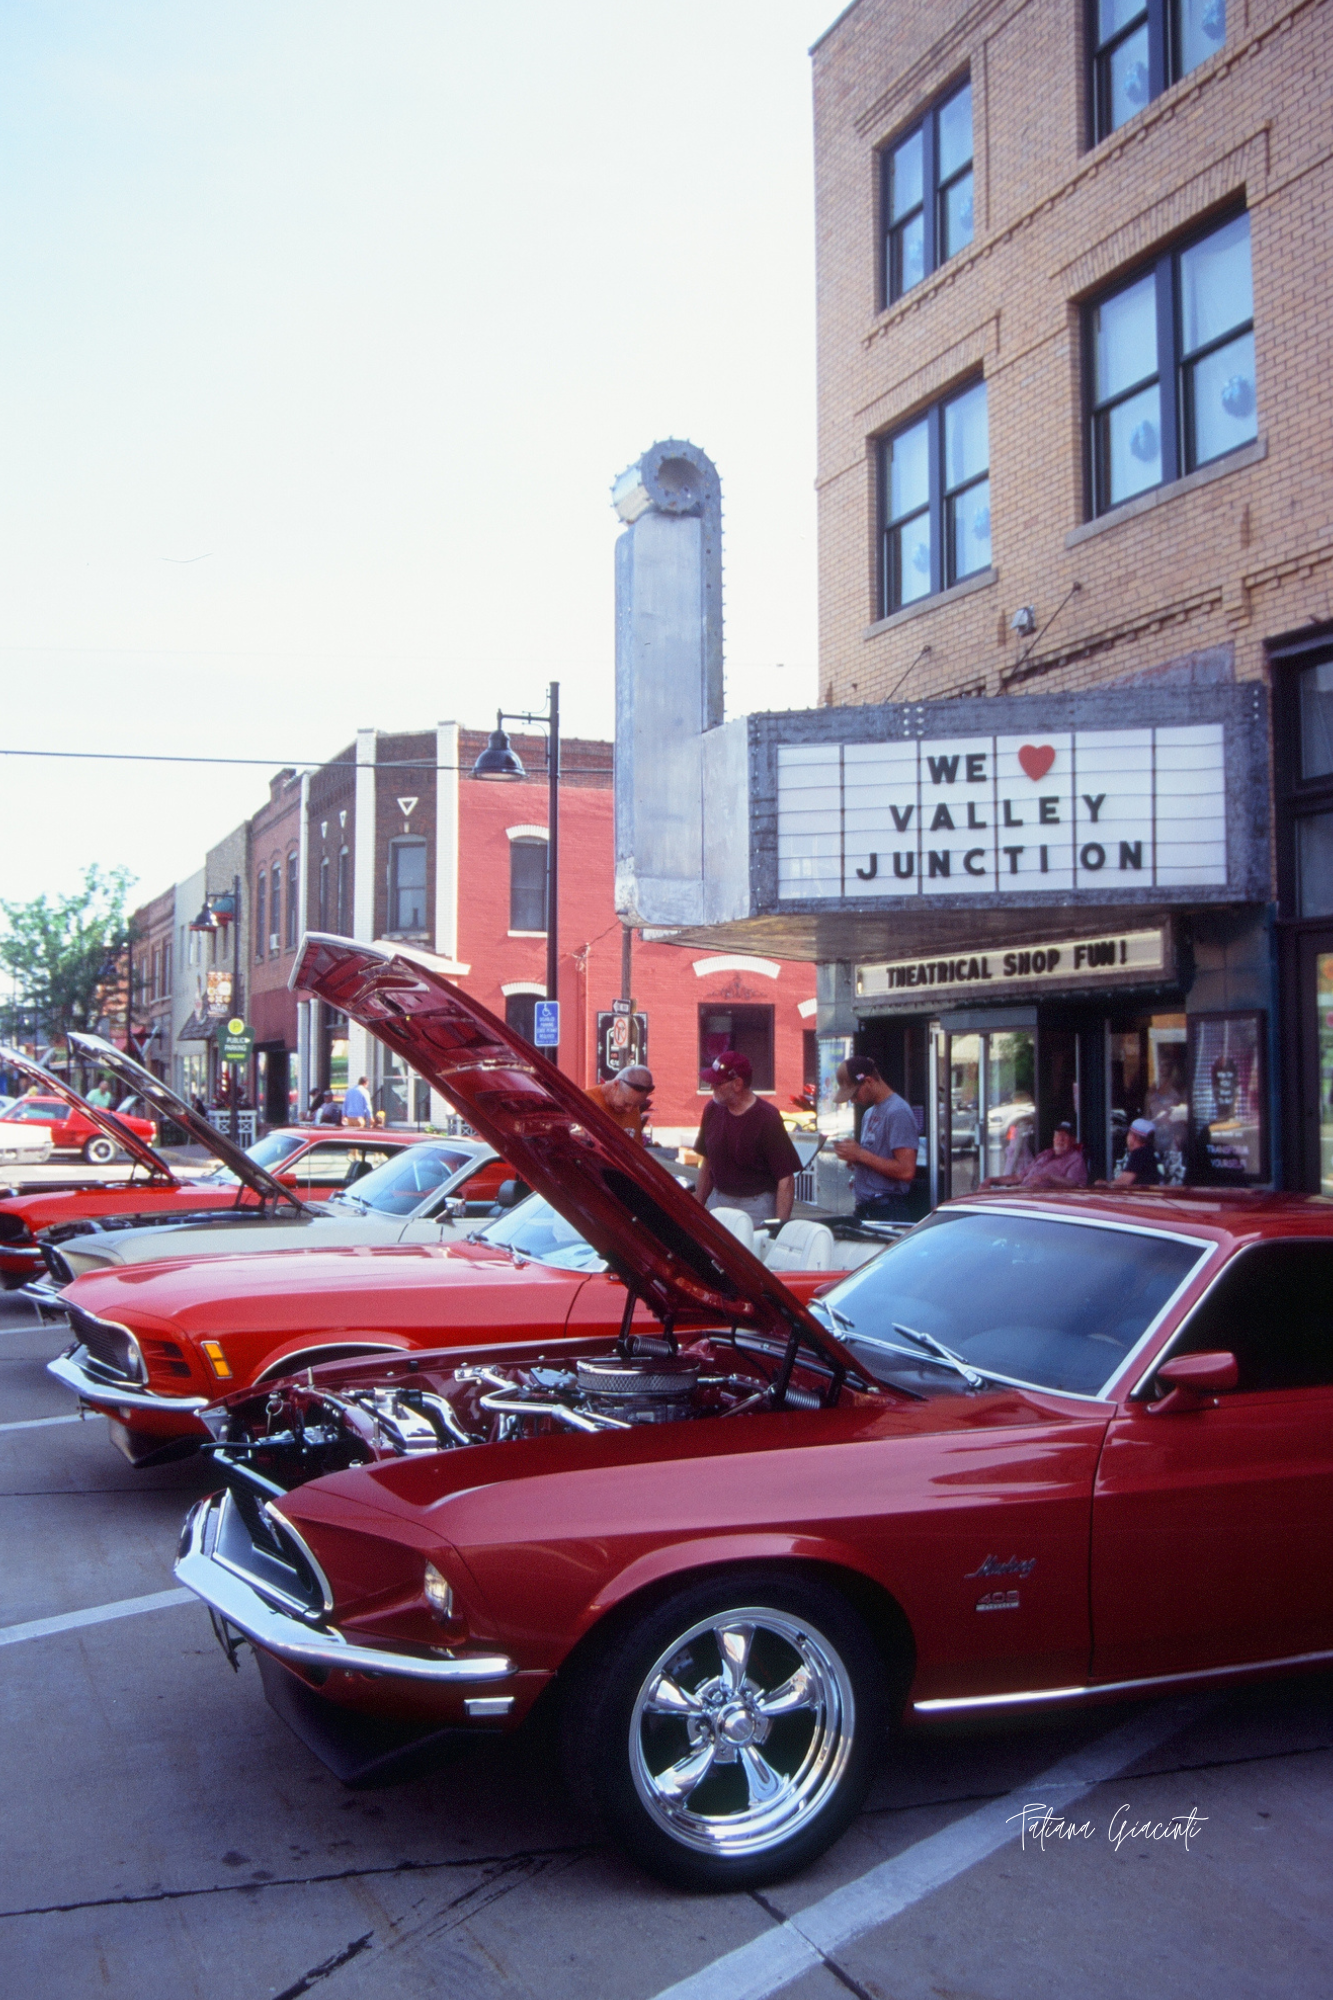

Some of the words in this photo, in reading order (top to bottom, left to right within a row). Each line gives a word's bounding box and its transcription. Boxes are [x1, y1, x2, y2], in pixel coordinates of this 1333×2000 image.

[927, 753, 988, 785] WE
[888, 793, 1107, 833] VALLEY
[855, 839, 1143, 881] JUNCTION
[886, 957, 993, 990] THEATRICAL
[1003, 948, 1061, 977] SHOP
[226, 1036, 246, 1044] PUBLIC
